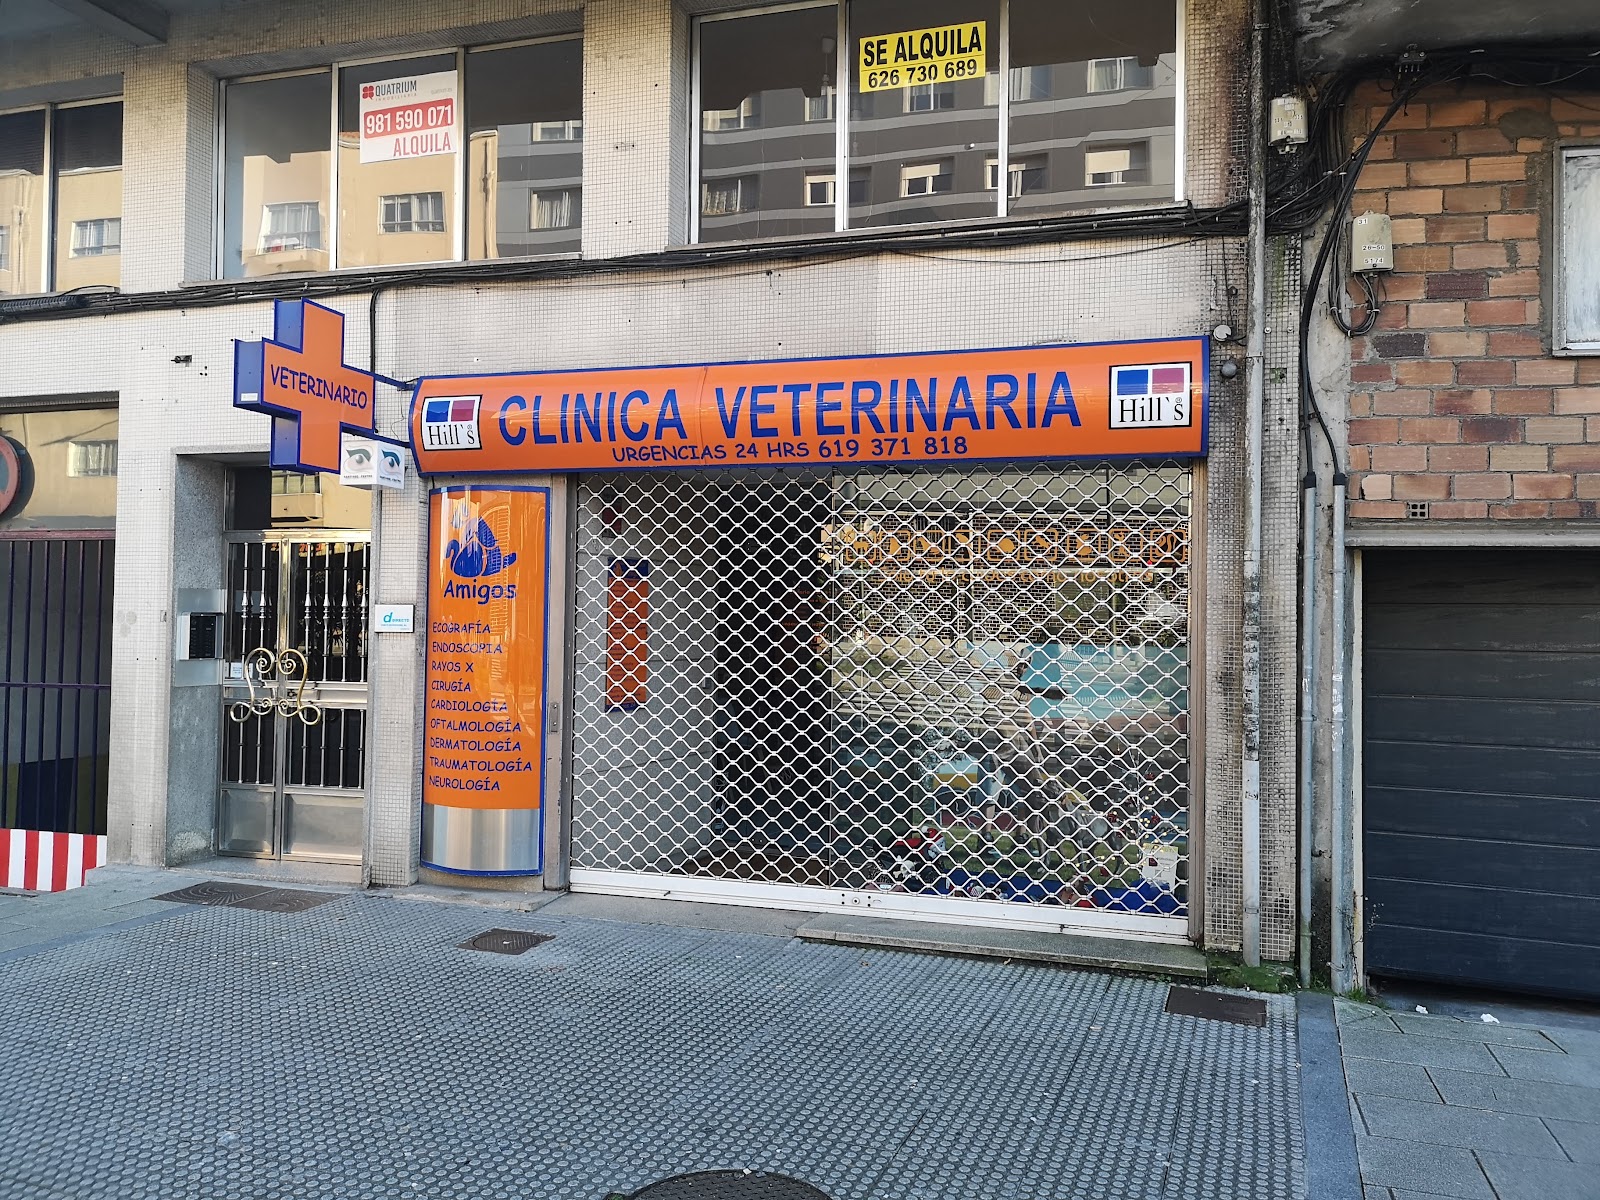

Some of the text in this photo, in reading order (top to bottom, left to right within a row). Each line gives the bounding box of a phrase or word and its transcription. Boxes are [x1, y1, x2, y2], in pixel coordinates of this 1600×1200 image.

[863, 26, 982, 67] SE ALQUILA
[868, 58, 977, 88] 626 730 689
[375, 80, 417, 97] QUATRIUM
[366, 104, 452, 134] 981 590 071
[393, 131, 451, 157] ALQUILA
[270, 363, 368, 409] VETERINARIO
[498, 371, 1082, 446] CLINICA VETERINARIA
[612, 436, 968, 462] URGENCIAS 24 HRS 619 371 818
[443, 578, 517, 605] Amigos
[432, 620, 491, 634] ECOGRAFÍA
[432, 641, 503, 654] ENDOSCOPIA
[431, 661, 474, 673] RAYOS X
[431, 678, 471, 692] CIRUGÍA
[430, 699, 508, 712] CARDIOLOGÍA
[430, 718, 521, 733] OFTALMOLOGÍA
[430, 737, 521, 752] DERMATOLOGÍA
[429, 756, 533, 772] TRAUMATOLOGÍA
[429, 775, 500, 791] NEUROLOGÍA
